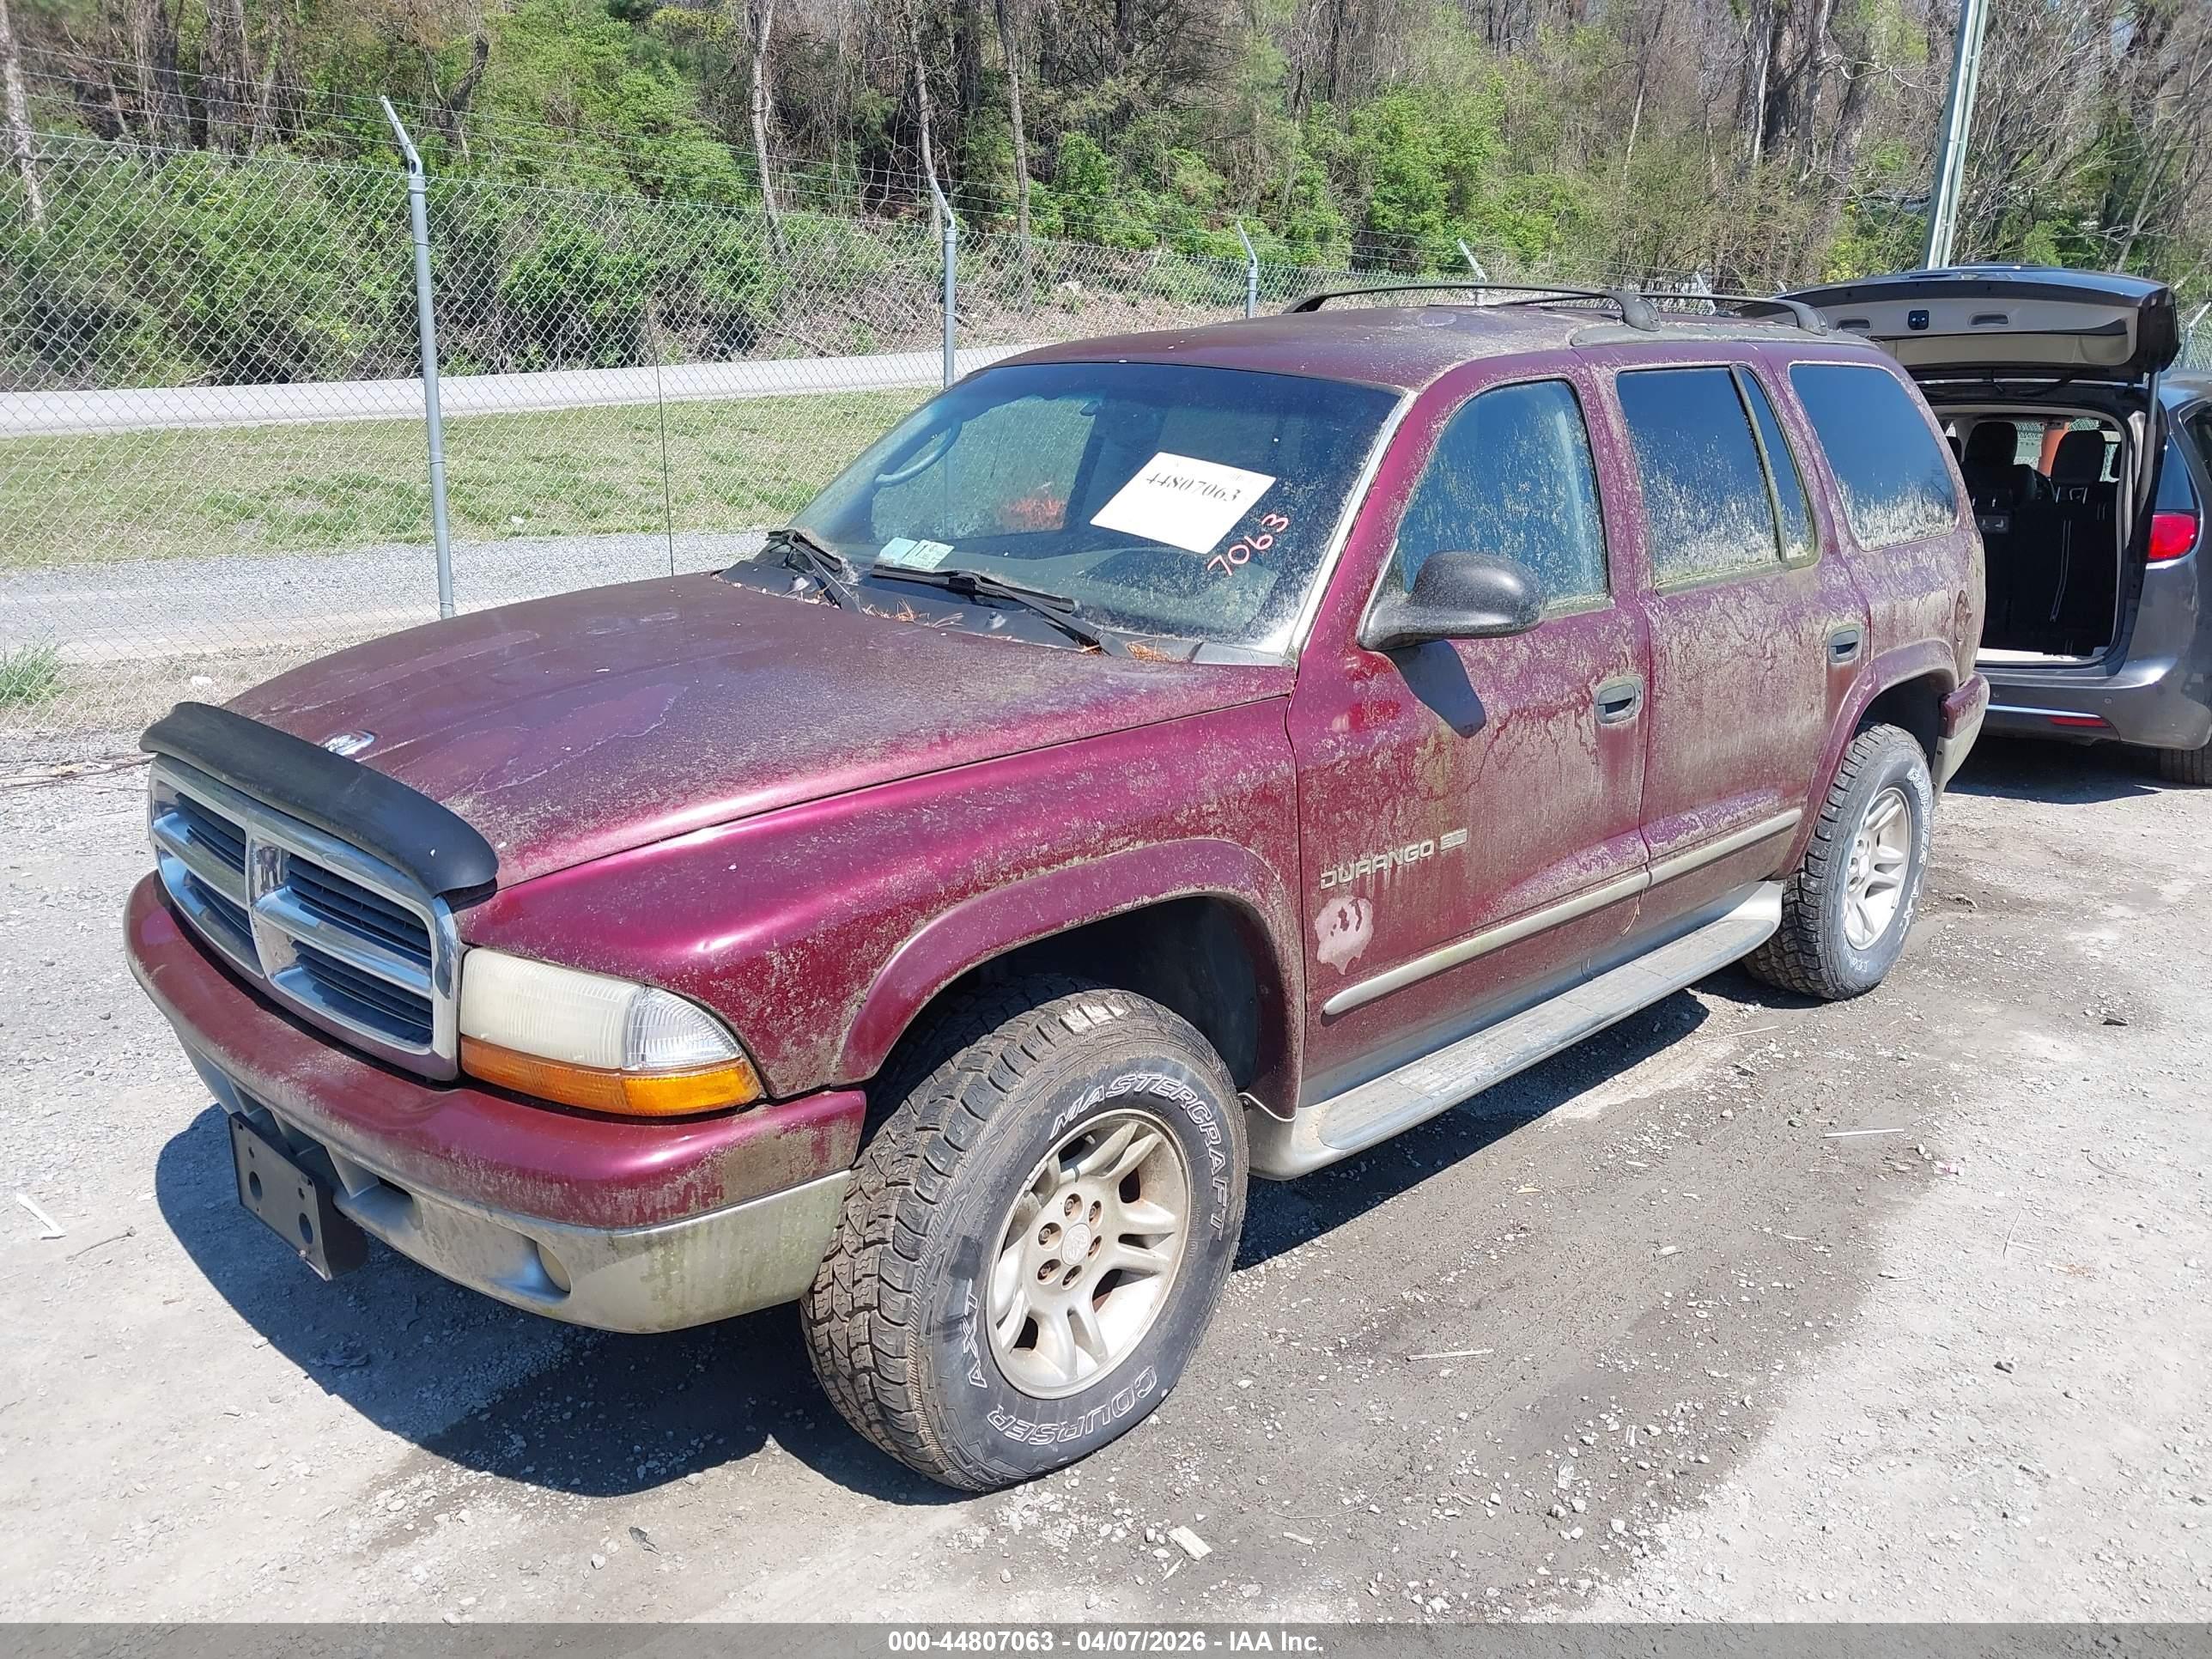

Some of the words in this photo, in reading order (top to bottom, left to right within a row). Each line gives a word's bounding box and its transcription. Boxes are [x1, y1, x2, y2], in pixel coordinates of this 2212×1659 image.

[1146, 472, 1241, 501] 44807063
[1206, 513, 1290, 577] 7063
[1320, 840, 1435, 890] DURANGO
[1048, 1072, 1229, 1242] MASTERCRAFT
[988, 1365, 1158, 1446] COURSER
